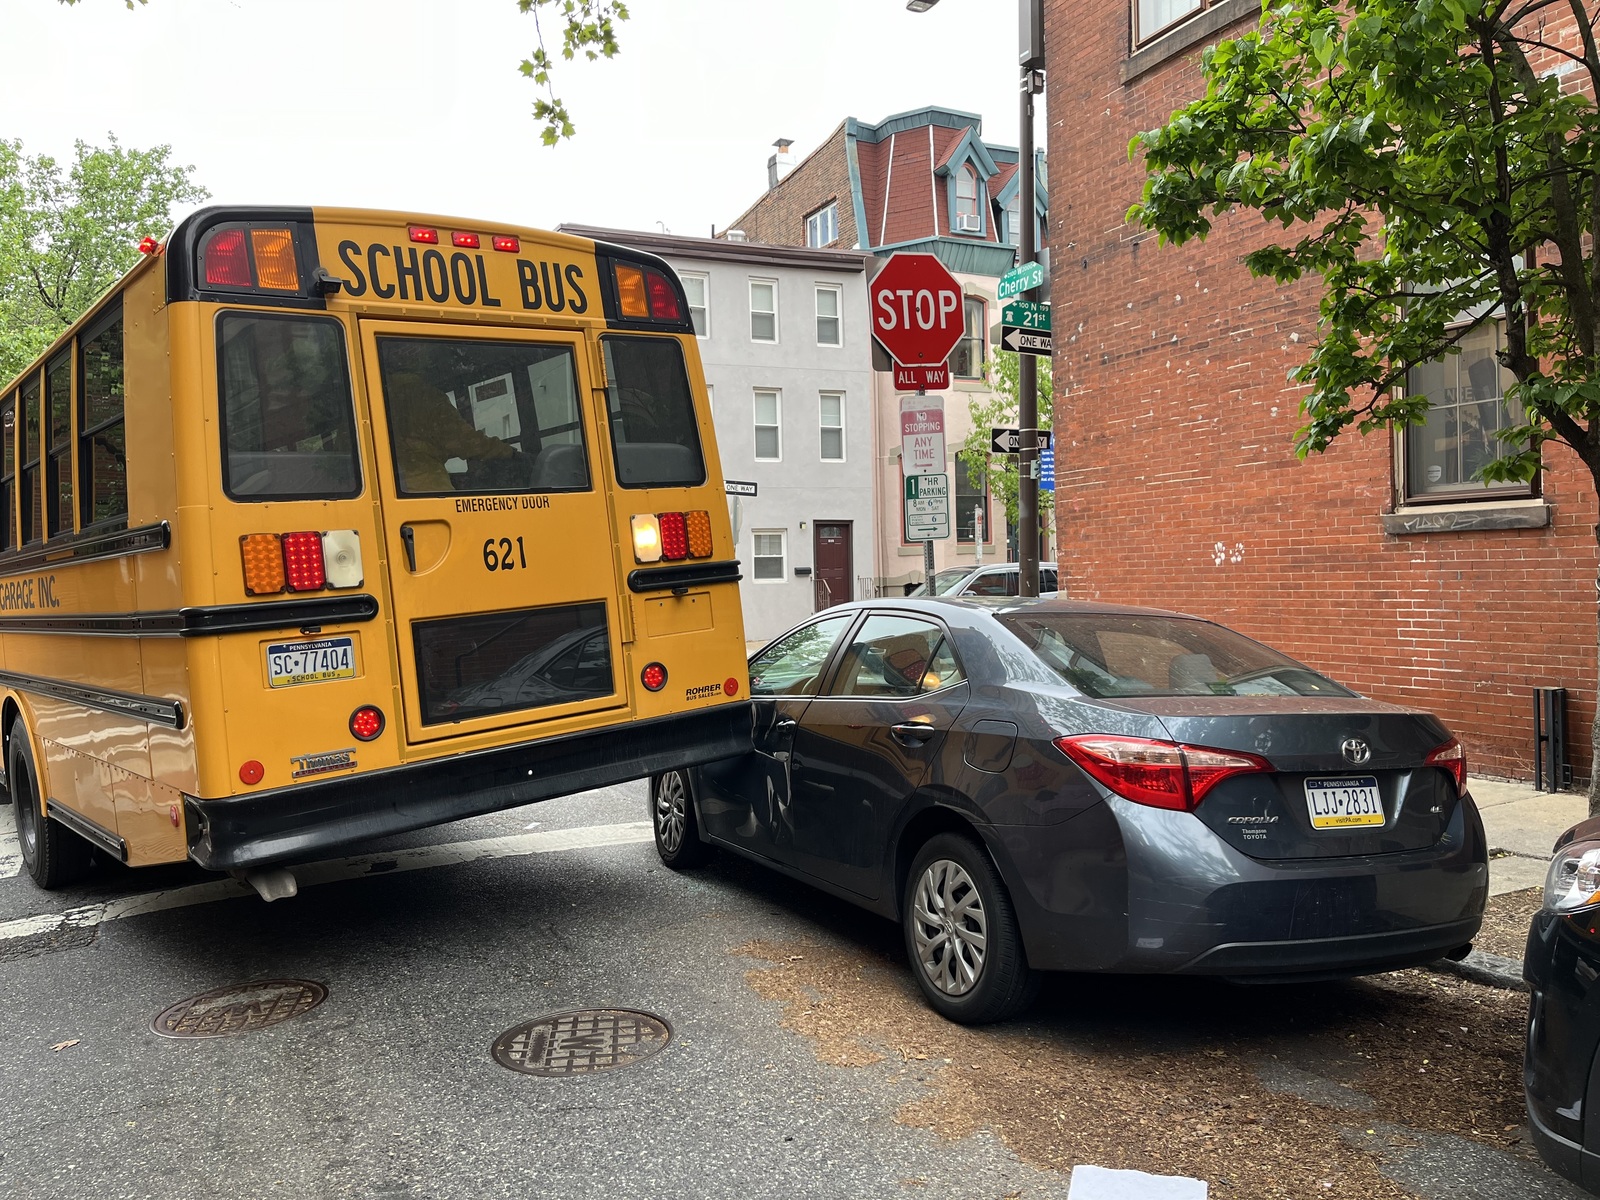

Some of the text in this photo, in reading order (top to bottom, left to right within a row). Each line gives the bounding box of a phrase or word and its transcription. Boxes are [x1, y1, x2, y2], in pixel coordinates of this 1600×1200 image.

[338, 240, 588, 314] SCHOOL BUS
[998, 269, 1042, 298] Cherry St
[877, 289, 957, 330] STOP
[1030, 303, 1037, 311] N
[1023, 311, 1046, 327] 21st
[1020, 335, 1051, 349] ONE WA
[898, 370, 945, 384] ALL WAY
[916, 411, 927, 421] NO
[904, 421, 941, 433] STOPPING
[914, 436, 933, 448] ANY
[1009, 436, 1019, 446] ON
[913, 448, 935, 460] TIME
[910, 476, 938, 495] 1 HR
[919, 486, 947, 497] PARKING
[455, 495, 550, 513] EMERGENCY DOOR
[483, 536, 527, 572] 621
[0, 575, 60, 611] GARAGE INC.
[289, 641, 332, 651] PENNSYLVANIA
[292, 670, 336, 682] SCHOOL BUS
[685, 683, 721, 696] ROHRER
[290, 747, 356, 770] Thomas
[1323, 779, 1360, 788] PENNSYLVANIA
